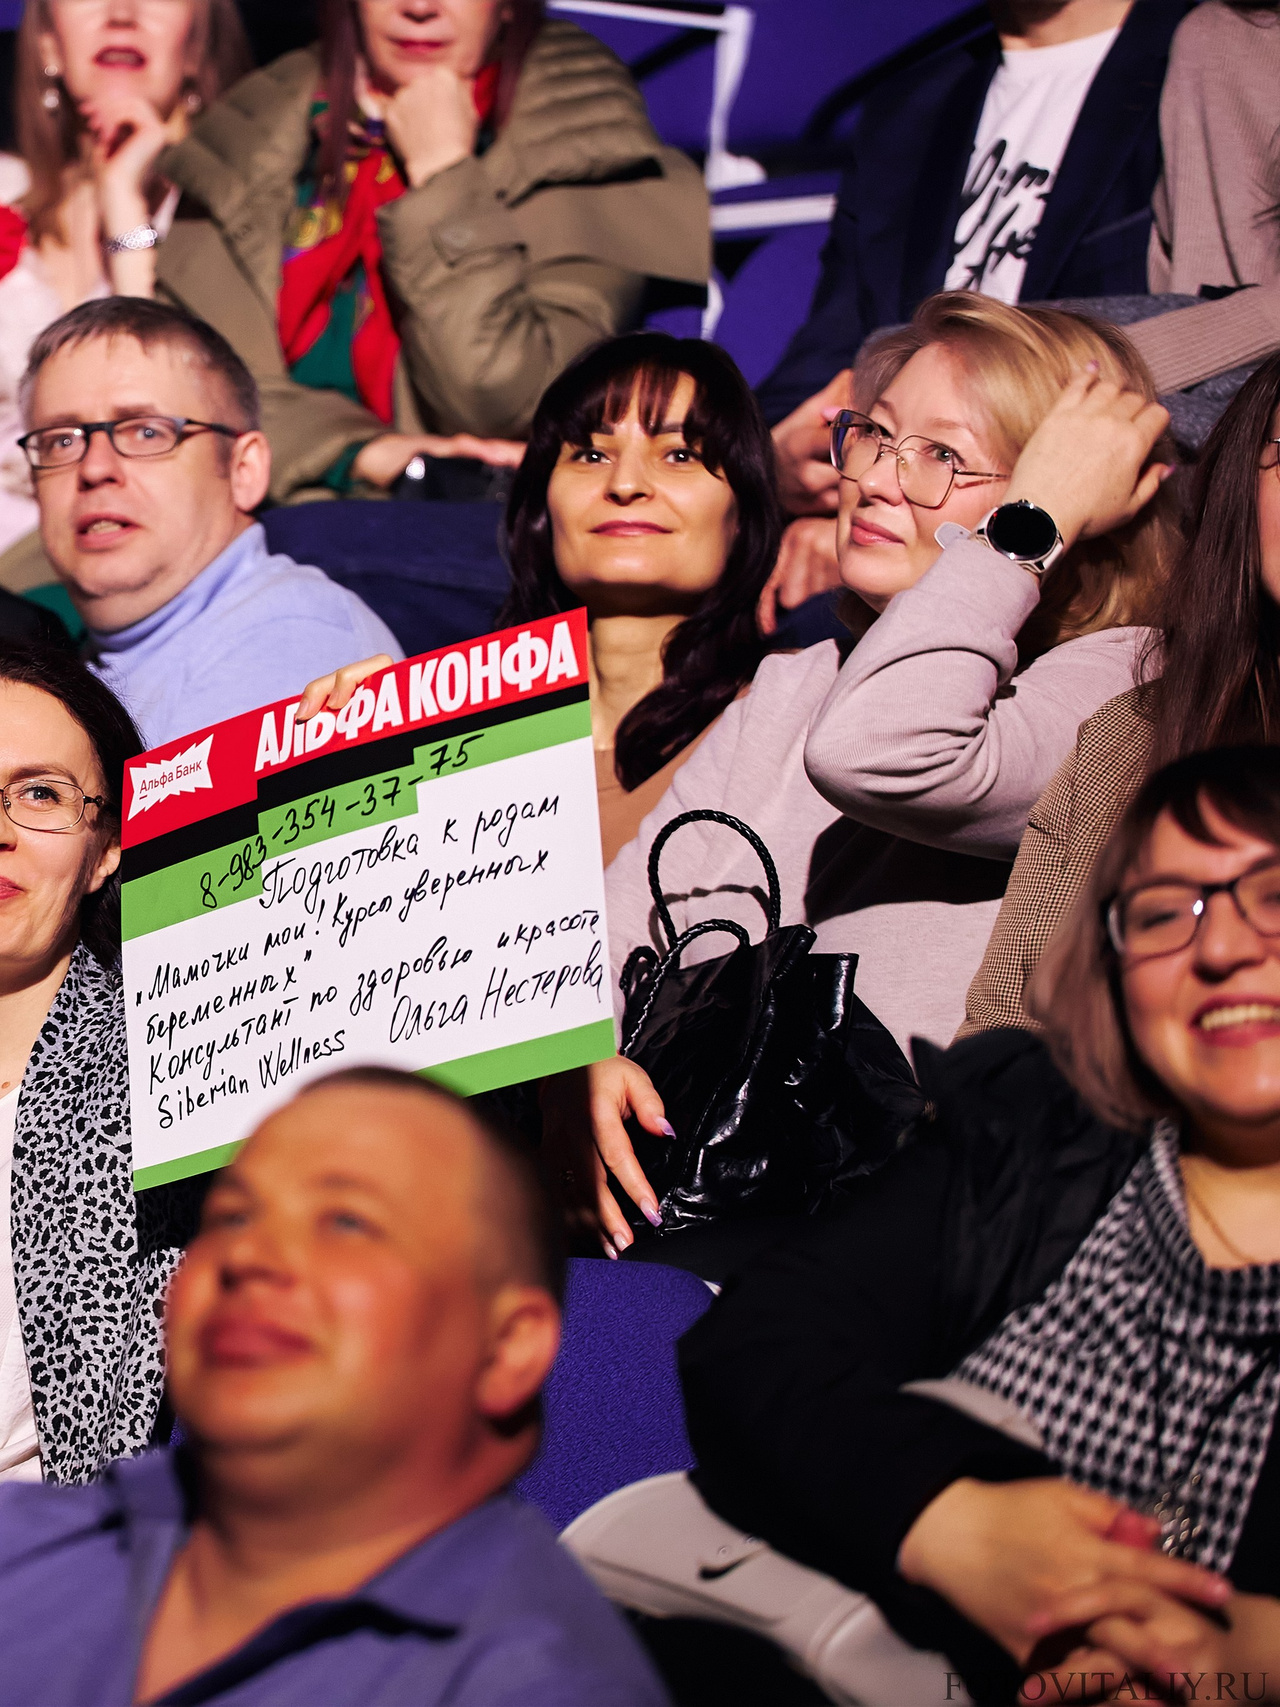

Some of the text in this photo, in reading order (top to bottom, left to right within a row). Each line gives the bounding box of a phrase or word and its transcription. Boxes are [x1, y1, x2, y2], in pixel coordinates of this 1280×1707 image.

[254, 620, 580, 773] АЛЬФА КОНФА
[139, 759, 202, 800] Альфа Банк
[200, 734, 485, 909] 8-983-354-37-75
[259, 796, 560, 914] Подготовка к родам
[332, 892, 393, 948] Курсы
[398, 850, 549, 923] уверенных
[149, 996, 300, 1095] Консультант
[310, 985, 338, 1013] по
[349, 935, 473, 1017] здоровью
[389, 940, 603, 1044] Ольга Нестерова
[157, 1029, 346, 1129] Siberian Wellness
